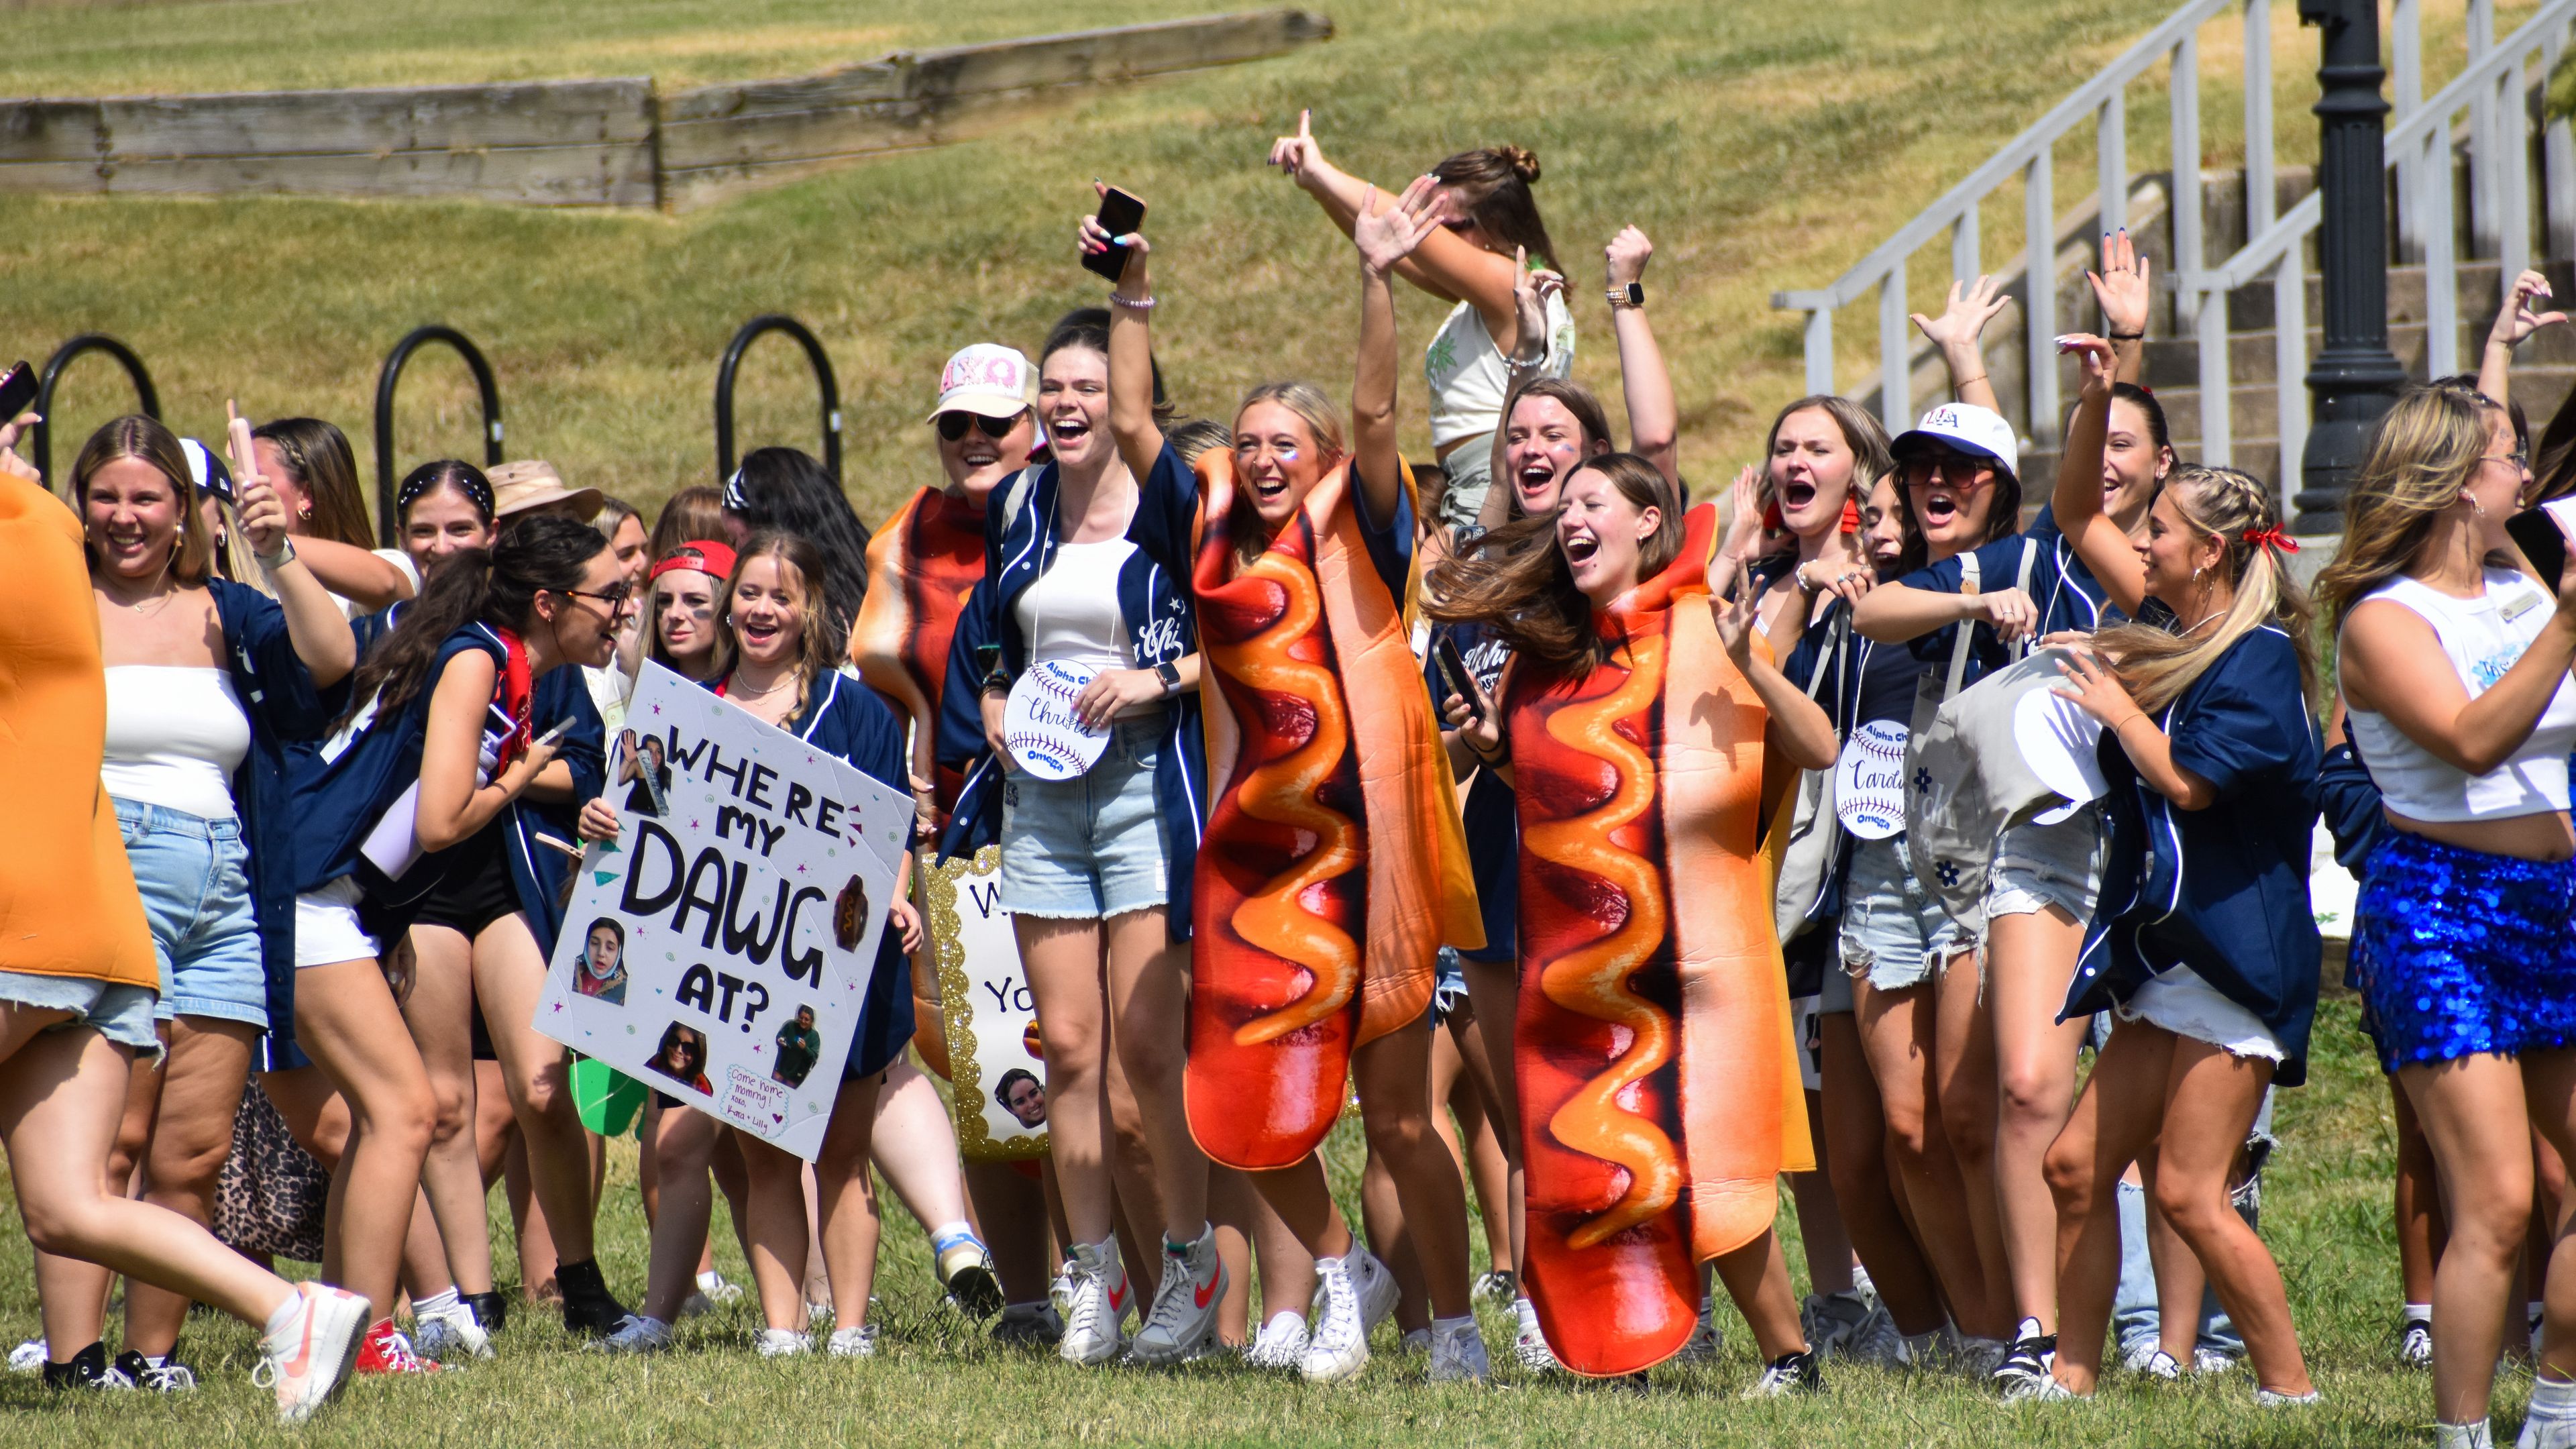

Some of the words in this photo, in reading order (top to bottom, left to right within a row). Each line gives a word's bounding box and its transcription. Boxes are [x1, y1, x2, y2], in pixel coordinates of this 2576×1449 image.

[1139, 617, 1183, 661] Chi
[1046, 661, 1075, 684] Alpha
[1866, 724, 1894, 742] Alpha
[1027, 750, 1064, 773] Omega
[1848, 759, 1904, 790] Caroli
[667, 725, 846, 839] WHERE
[1857, 814, 1890, 830] Omega
[619, 818, 827, 990] DAWG
[675, 963, 770, 1034] AT?
[731, 1069, 756, 1085] Come
[759, 1080, 783, 1098] home
[753, 1116, 767, 1135] Lilly
